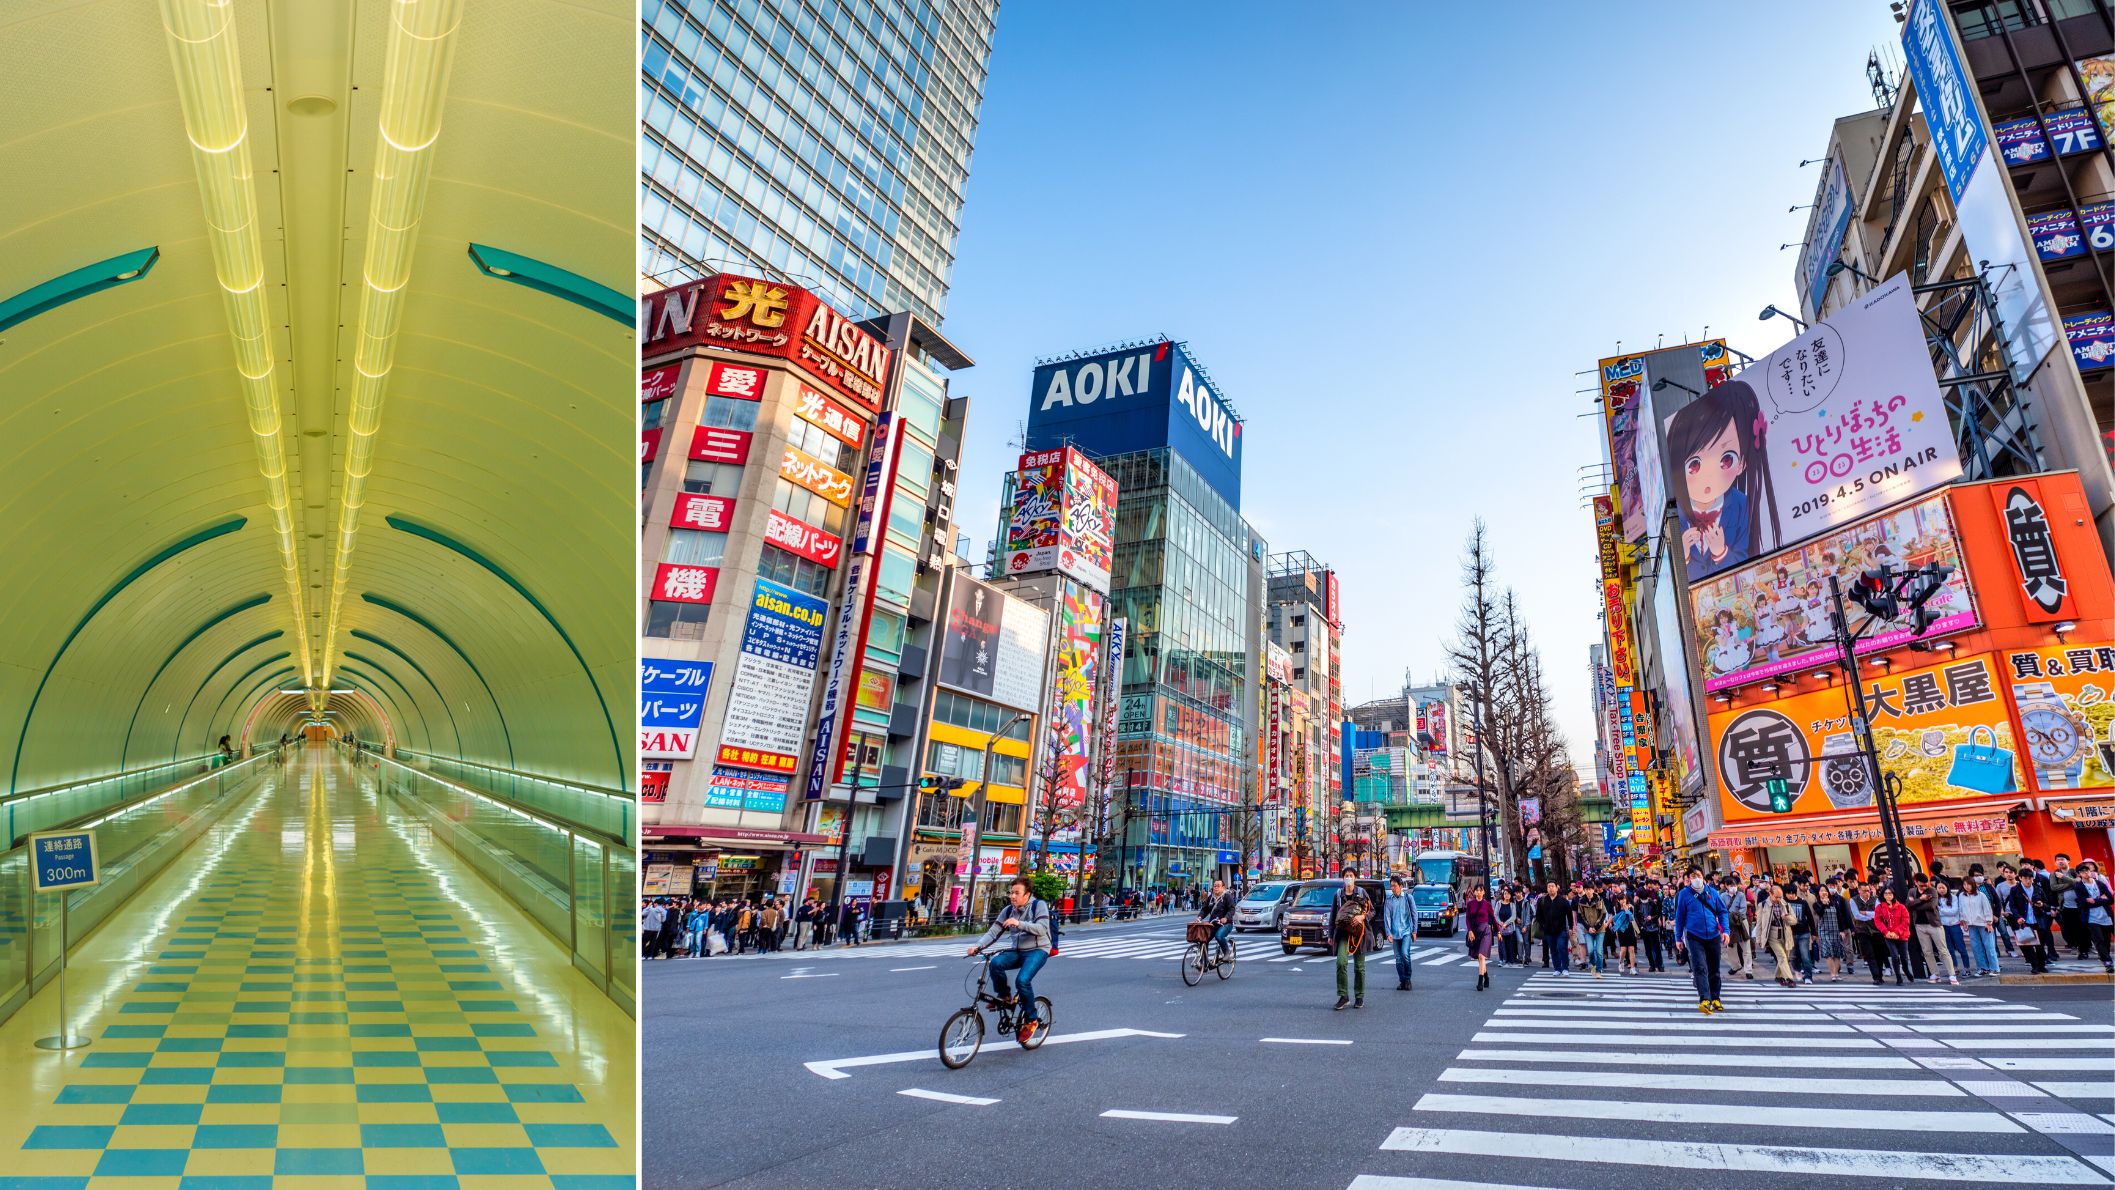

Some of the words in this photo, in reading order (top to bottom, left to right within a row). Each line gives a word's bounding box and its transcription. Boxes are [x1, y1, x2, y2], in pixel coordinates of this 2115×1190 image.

[2053, 127, 2097, 154] 7F
[2090, 225, 2114, 248] 6
[720, 280, 788, 329] 光
[707, 322, 788, 347] ネットワーク
[805, 302, 890, 384] AISAN
[1811, 336, 1832, 377] 友達に
[717, 366, 758, 397] 愛
[1040, 353, 1151, 412] AOKI
[1796, 349, 1817, 397] なりたい
[796, 391, 863, 443] 光通信
[1178, 366, 1234, 460] AOKI
[1791, 395, 1907, 457] ひとりぼっちの
[701, 431, 741, 459] 三
[1025, 452, 1062, 468] 免税店
[781, 451, 852, 499] ネットワーク
[1792, 478, 1865, 520] 2019.4.5
[1869, 462, 1899, 485] ON
[1903, 446, 1938, 472] AIR
[856, 446, 885, 539] 愛三電機
[684, 498, 725, 529] 電
[765, 514, 839, 561] 配線パーツ
[664, 567, 708, 600] 機
[755, 593, 824, 627] aisan.co.jp
[1112, 622, 1123, 662] AKKY
[642, 665, 706, 687] ケーブル
[1863, 658, 1996, 725] 大黒屋
[642, 700, 698, 720] パーツ
[1123, 711, 1145, 719] OPEN
[722, 747, 740, 761] 各社
[810, 719, 832, 793] AISAN
[1614, 752, 1625, 779] Shop
[1630, 785, 1646, 793] DVD
[1953, 818, 2007, 833] 無料査定
[2077, 805, 2115, 819] 1階に
[44, 838, 83, 853] 連絡通路
[46, 866, 86, 882] 300m
